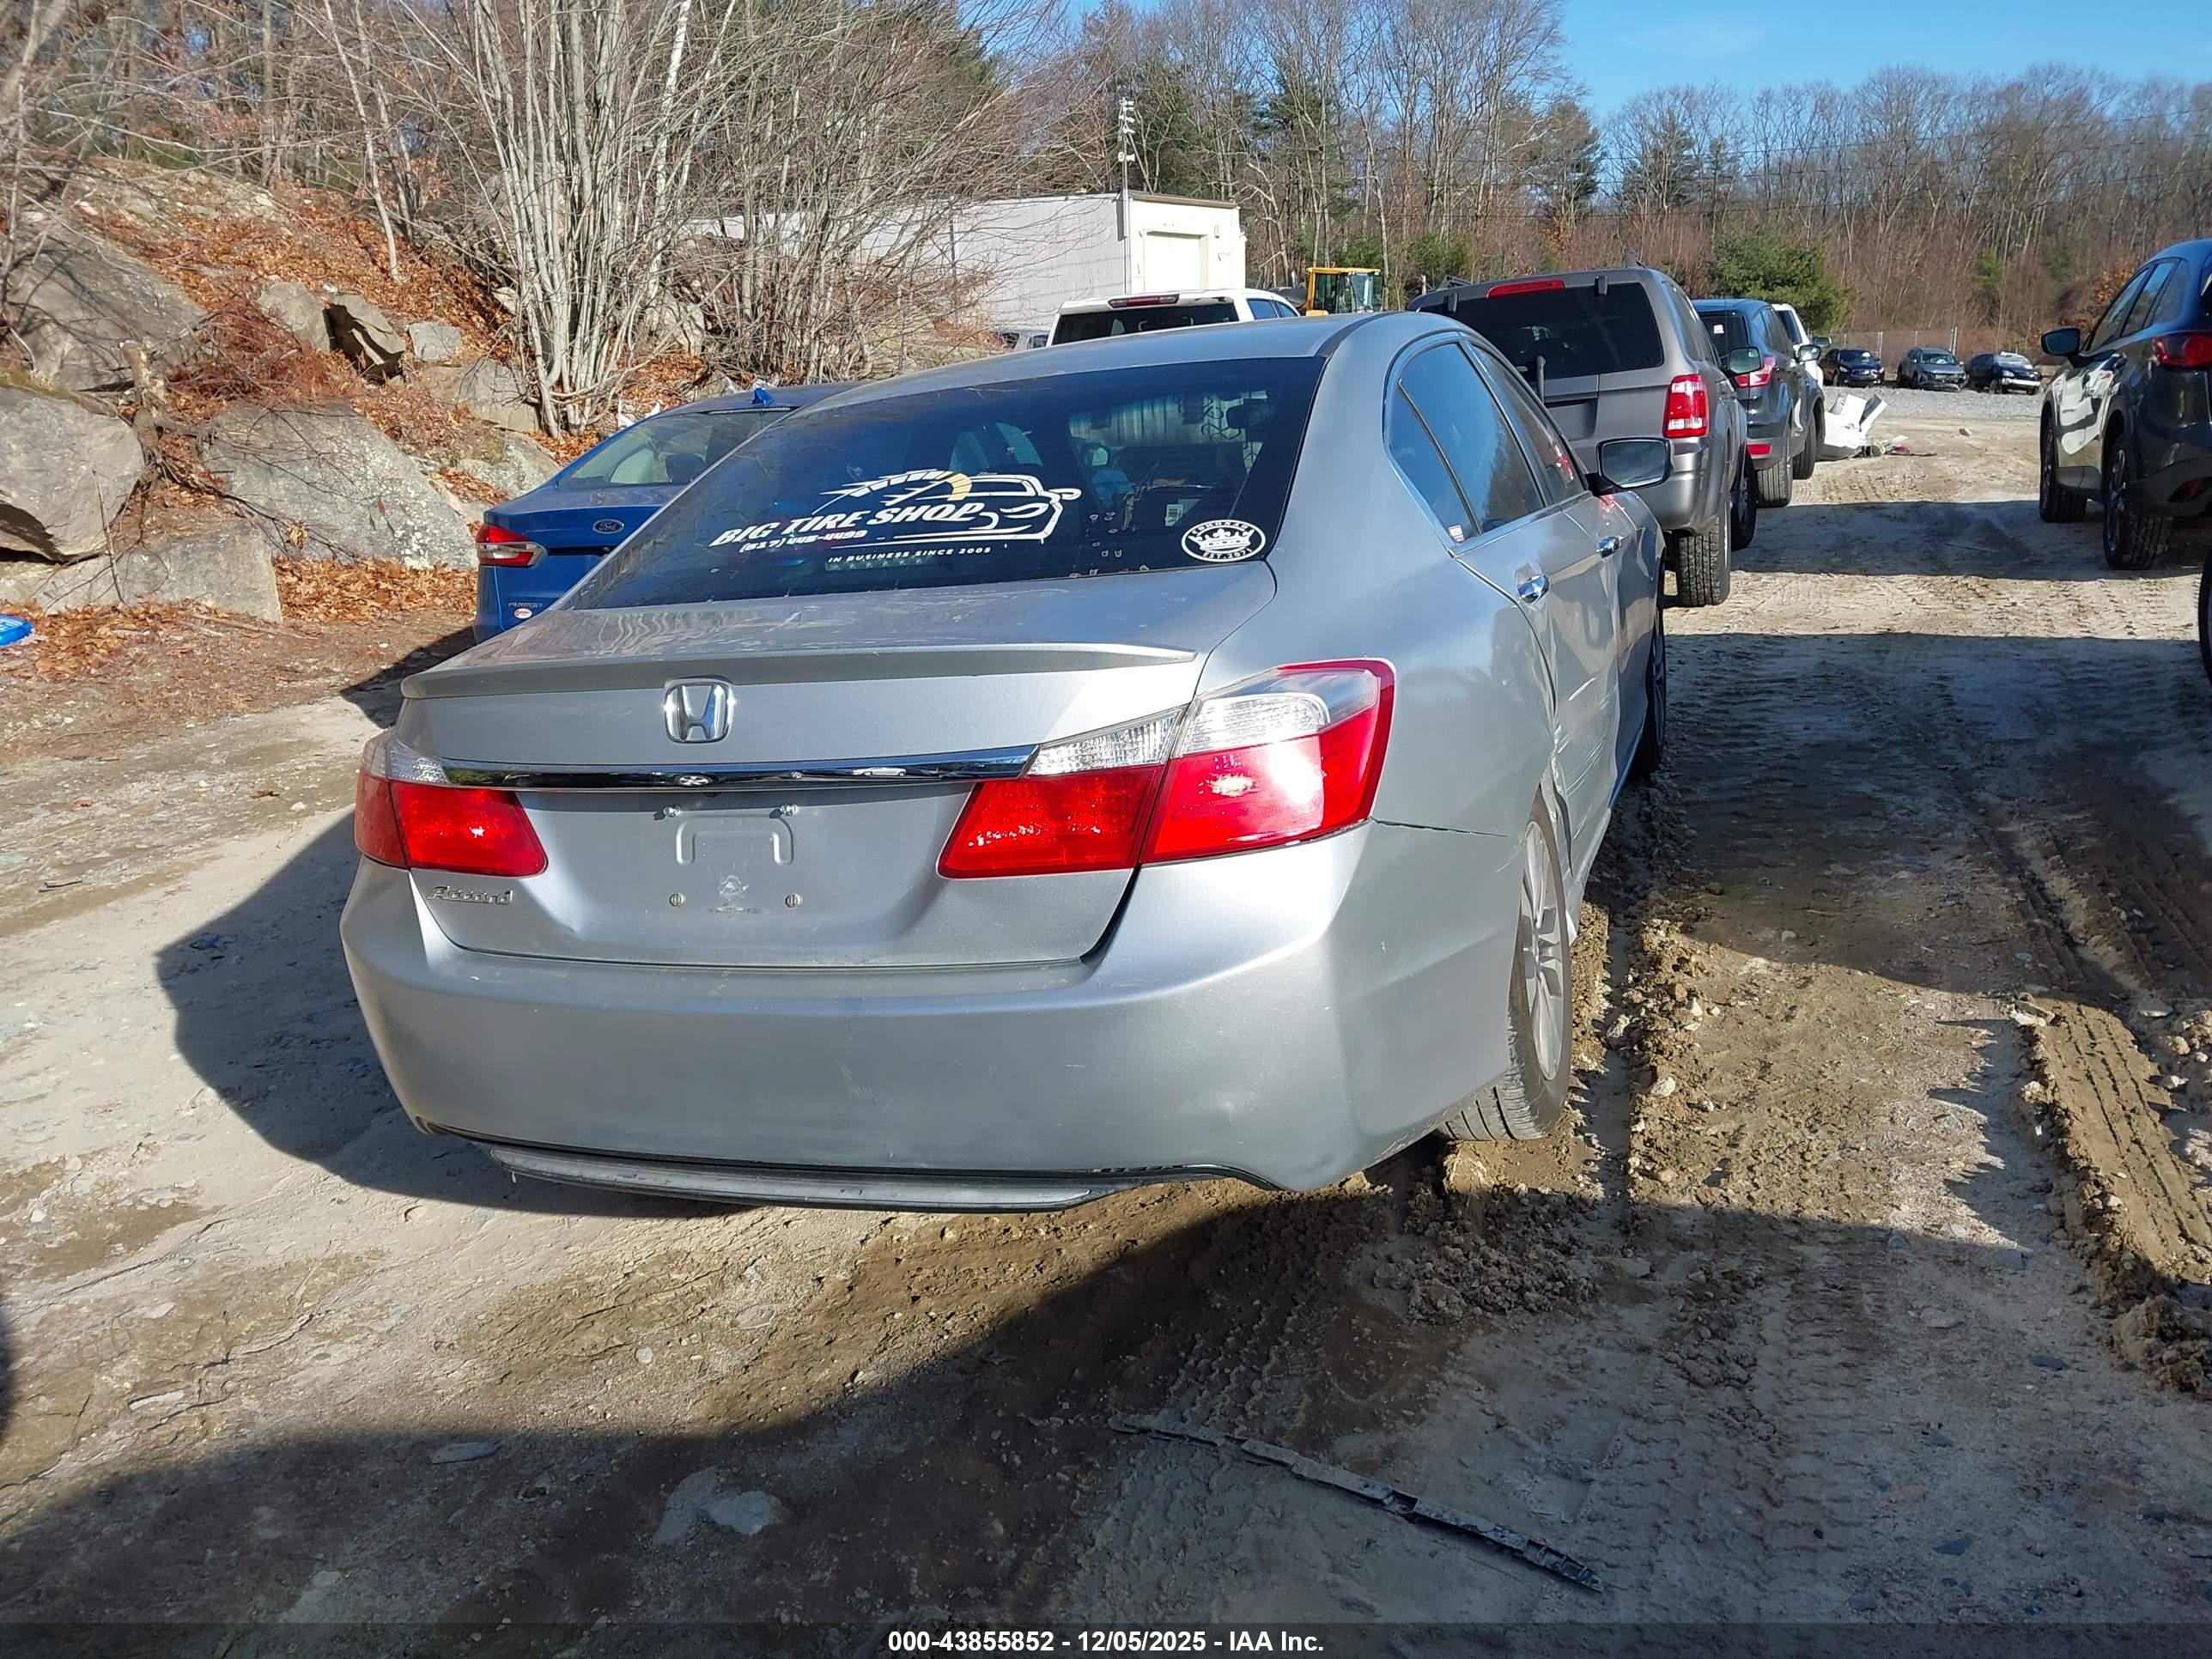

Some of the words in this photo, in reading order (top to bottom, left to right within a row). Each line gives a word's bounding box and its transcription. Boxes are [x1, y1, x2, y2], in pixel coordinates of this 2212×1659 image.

[708, 522, 781, 547] BIG
[781, 510, 872, 535] TIRE
[866, 502, 985, 526] SHOP
[846, 551, 910, 562] BUSINESS
[915, 548, 955, 557] SINCE
[426, 885, 514, 905] Accord
